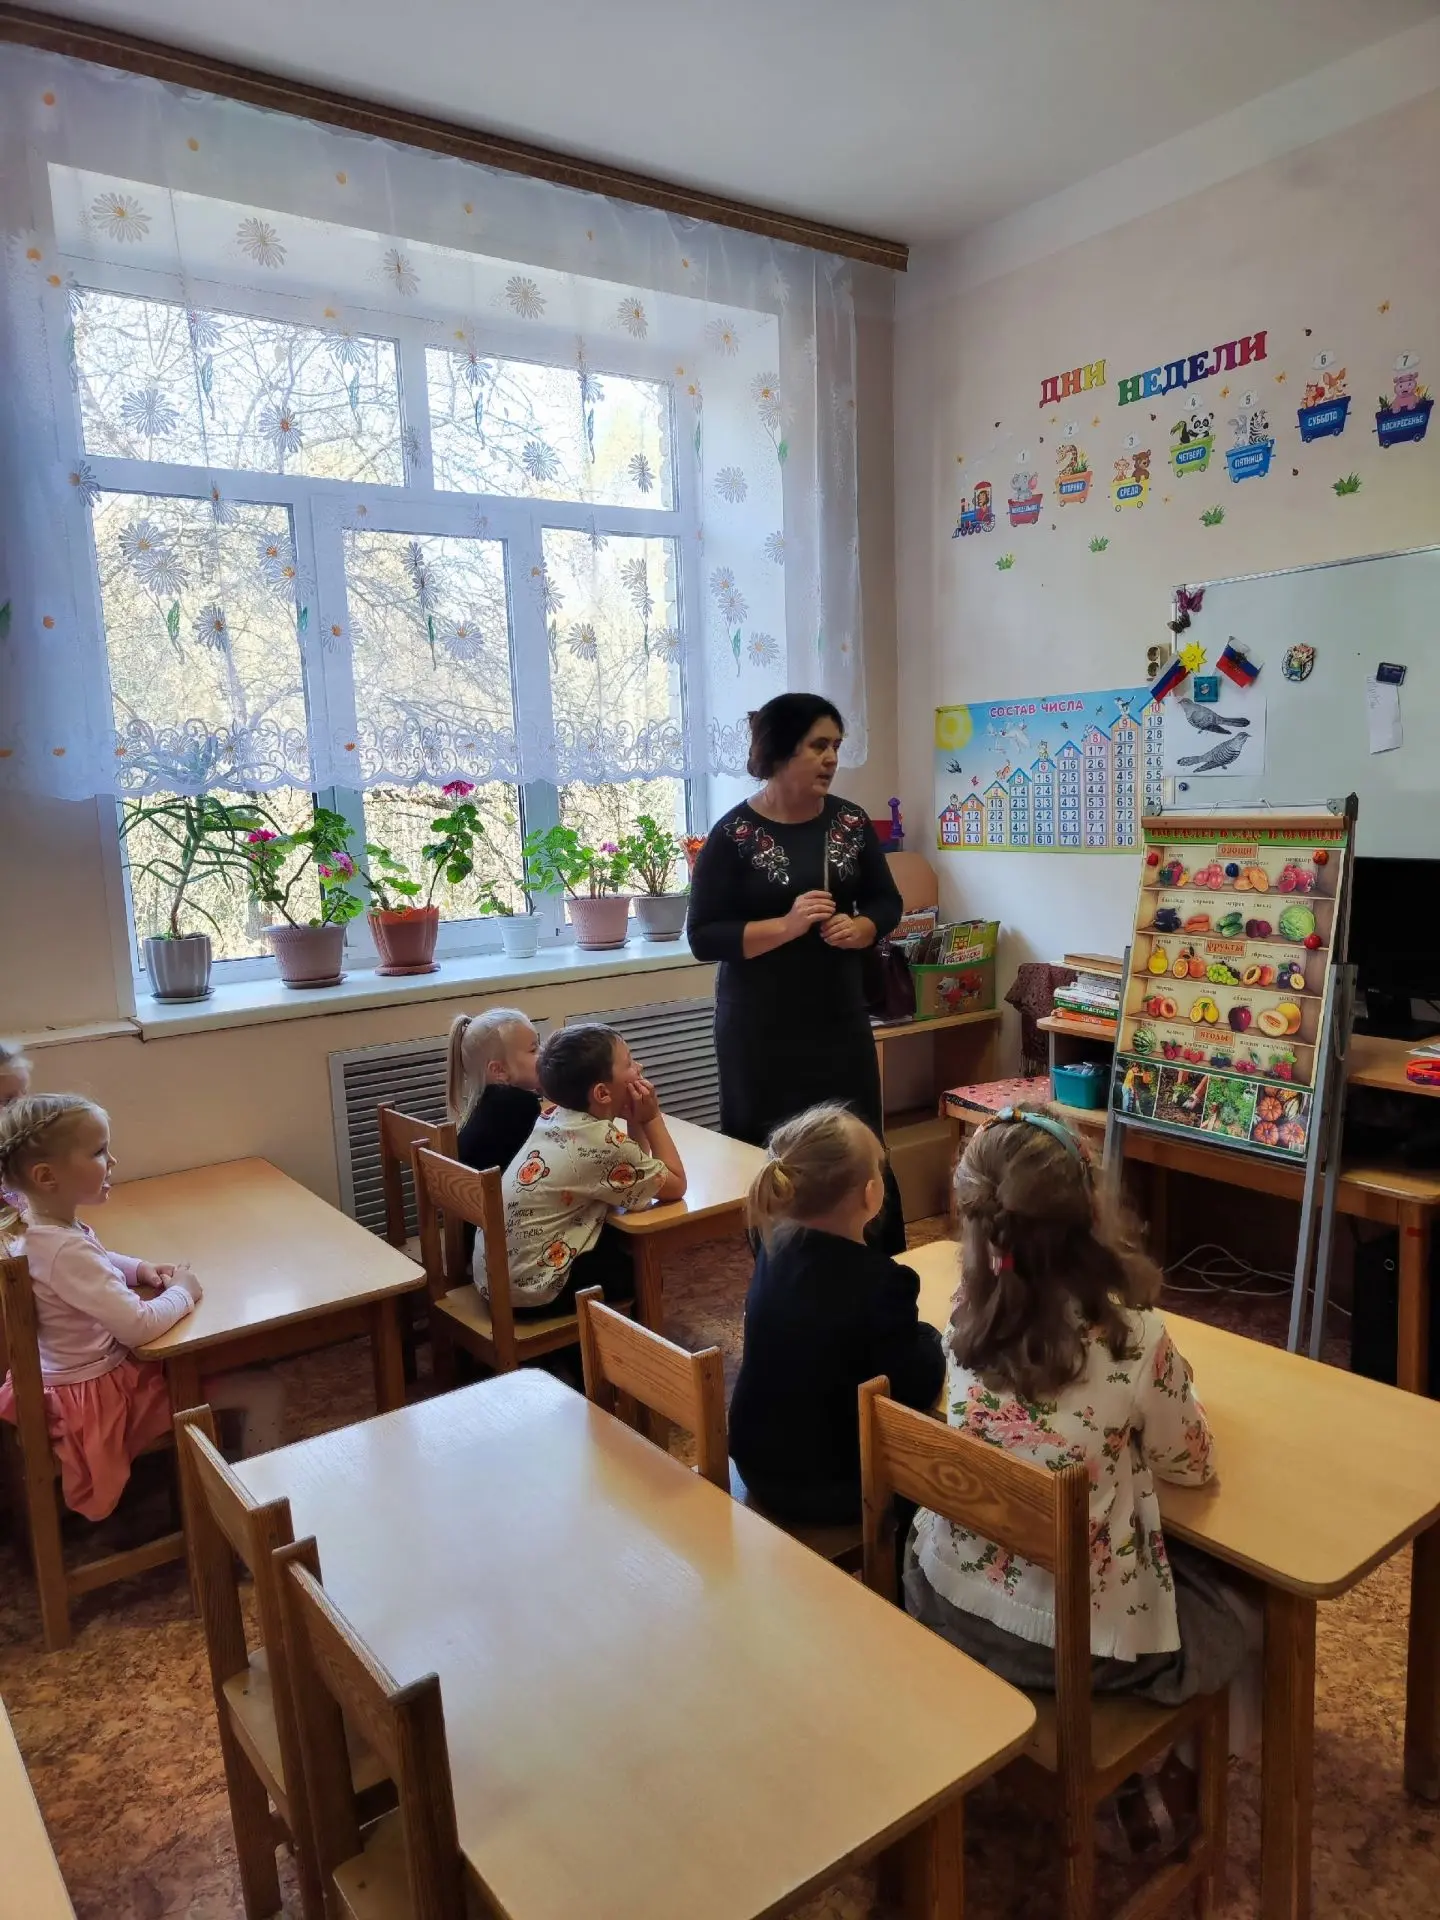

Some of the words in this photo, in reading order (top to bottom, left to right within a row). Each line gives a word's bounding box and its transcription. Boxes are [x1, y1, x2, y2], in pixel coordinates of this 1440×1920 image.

[1321, 355, 1326, 365] 6
[1403, 355, 1409, 366] 7
[1039, 360, 1106, 408] ДНИ
[1118, 330, 1268, 406] НЕДЕЛИ
[1192, 399, 1196, 407] 4
[1246, 395, 1251, 405] 5
[1307, 410, 1338, 427] СУББОТА
[1382, 415, 1424, 431] ВОСКРЕСЕНЬЕ
[1068, 426, 1072, 435] 2
[1129, 437, 1134, 446] 3
[1178, 449, 1203, 462] ЧЕТВЕРГ
[1234, 453, 1263, 468] ПЯТНИЦА
[1120, 486, 1140, 497] СРЕДА
[990, 704, 1036, 718] СОСТАВ
[1041, 700, 1084, 712] ЧИСЛА
[1151, 703, 1160, 712] 10
[1122, 719, 1127, 727] 9
[1157, 717, 1163, 726] 9
[1093, 734, 1098, 742] 8
[1128, 732, 1133, 740] 8
[1147, 731, 1153, 739] 2
[1157, 730, 1162, 739] 8
[1067, 748, 1072, 757] 7
[1098, 747, 1103, 755] 7
[1117, 746, 1123, 754] 2
[1128, 745, 1133, 753] 7
[1147, 744, 1152, 752] 3
[1157, 743, 1162, 753] 7
[1088, 760, 1093, 768] 2
[1098, 760, 1103, 768] 6
[1117, 759, 1123, 767] 3
[1128, 758, 1133, 767] 6
[1156, 757, 1161, 766] 6
[1089, 773, 1093, 781] 3
[1098, 773, 1103, 781] 5
[1128, 771, 1133, 779] 5
[1147, 771, 1152, 779] 5
[1156, 771, 1161, 779] 5
[1062, 786, 1067, 794] 3
[1117, 785, 1123, 793] 5
[1127, 785, 1133, 793] 4
[1146, 784, 1151, 792] 6
[1156, 783, 1160, 792] 4
[1088, 798, 1094, 806] 5
[1099, 798, 1103, 806] 3
[1117, 798, 1123, 806] 6
[1128, 798, 1133, 806] 3
[1089, 811, 1094, 819] 6
[1099, 811, 1104, 819] 2
[1117, 823, 1123, 832] 8
[1063, 836, 1068, 844] 7
[1072, 836, 1077, 844] 0
[1089, 837, 1094, 845] 8
[1099, 837, 1104, 845] 0
[1117, 837, 1123, 845] 9
[1128, 837, 1133, 845] 0
[1208, 941, 1243, 952] ФРУКТЫ
[1200, 1031, 1230, 1041] ЯГОДЫ
